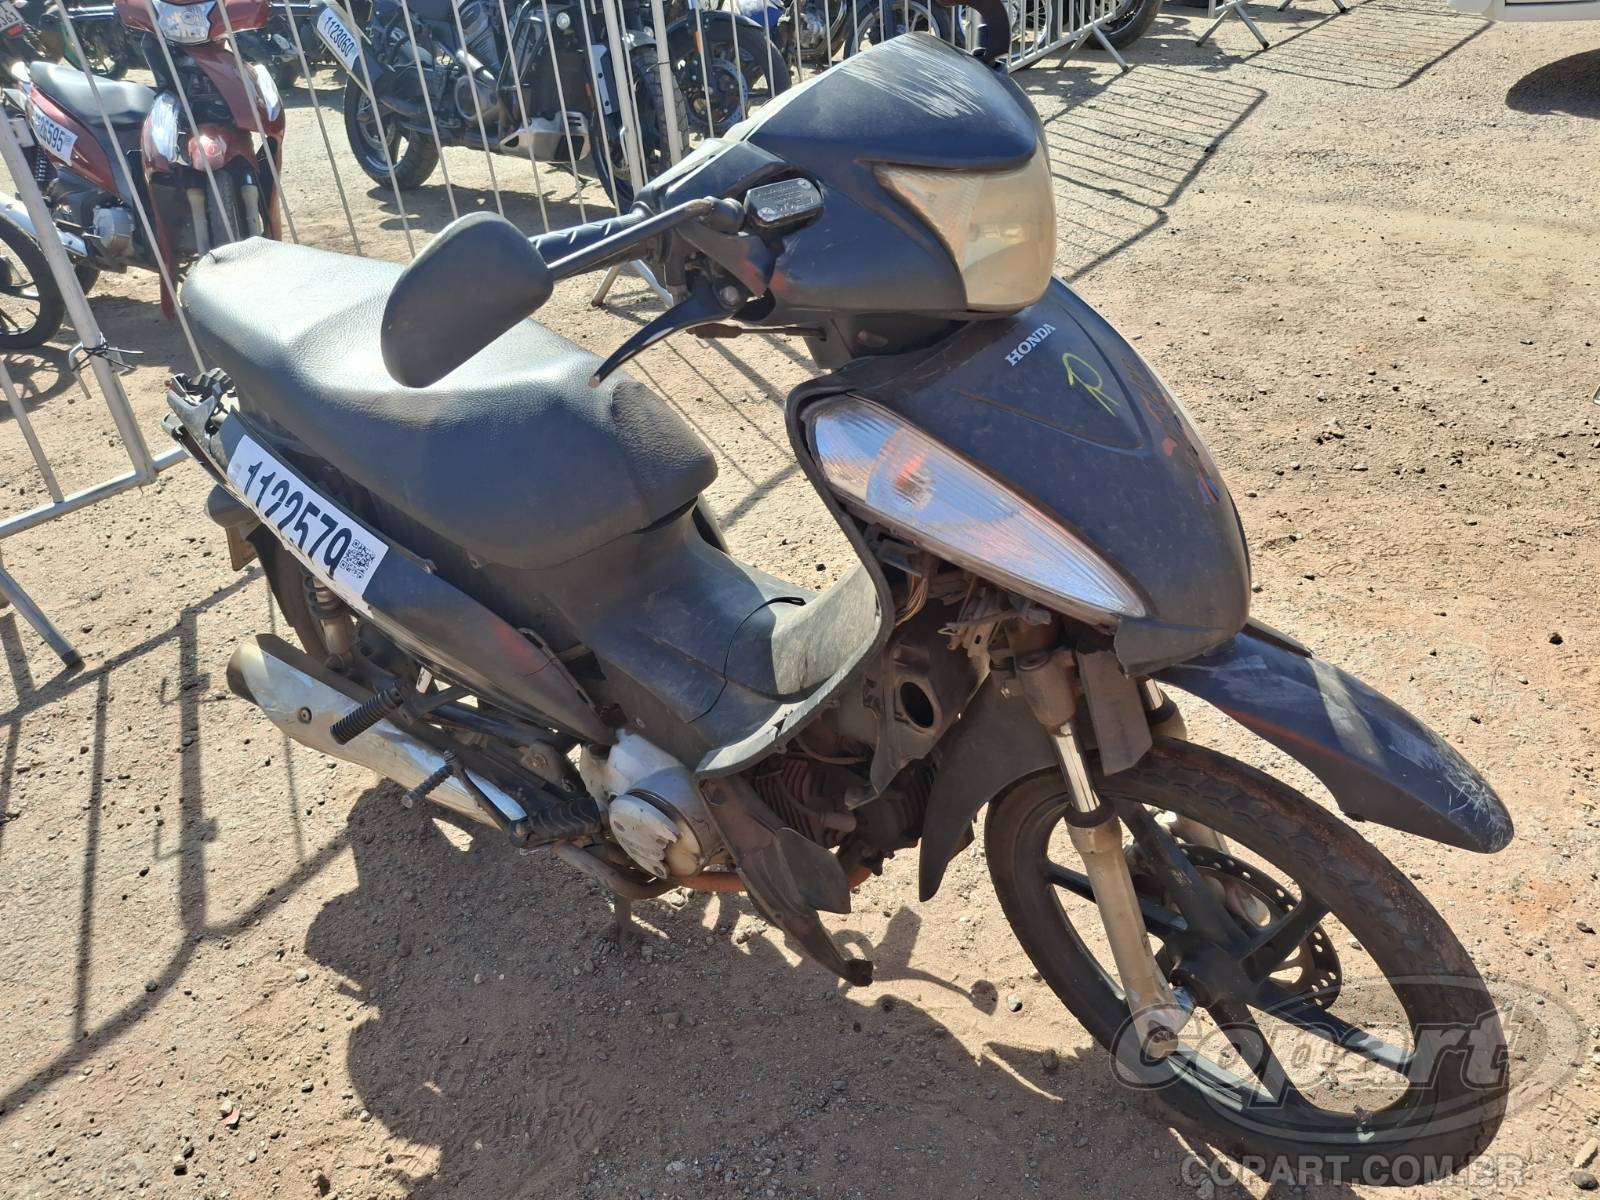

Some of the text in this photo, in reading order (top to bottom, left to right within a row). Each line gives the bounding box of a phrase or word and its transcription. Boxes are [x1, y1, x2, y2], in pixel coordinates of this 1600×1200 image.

[323, 16, 355, 57] 1123060
[1004, 323, 1056, 366] HONDA
[244, 461, 352, 580] 1122579
